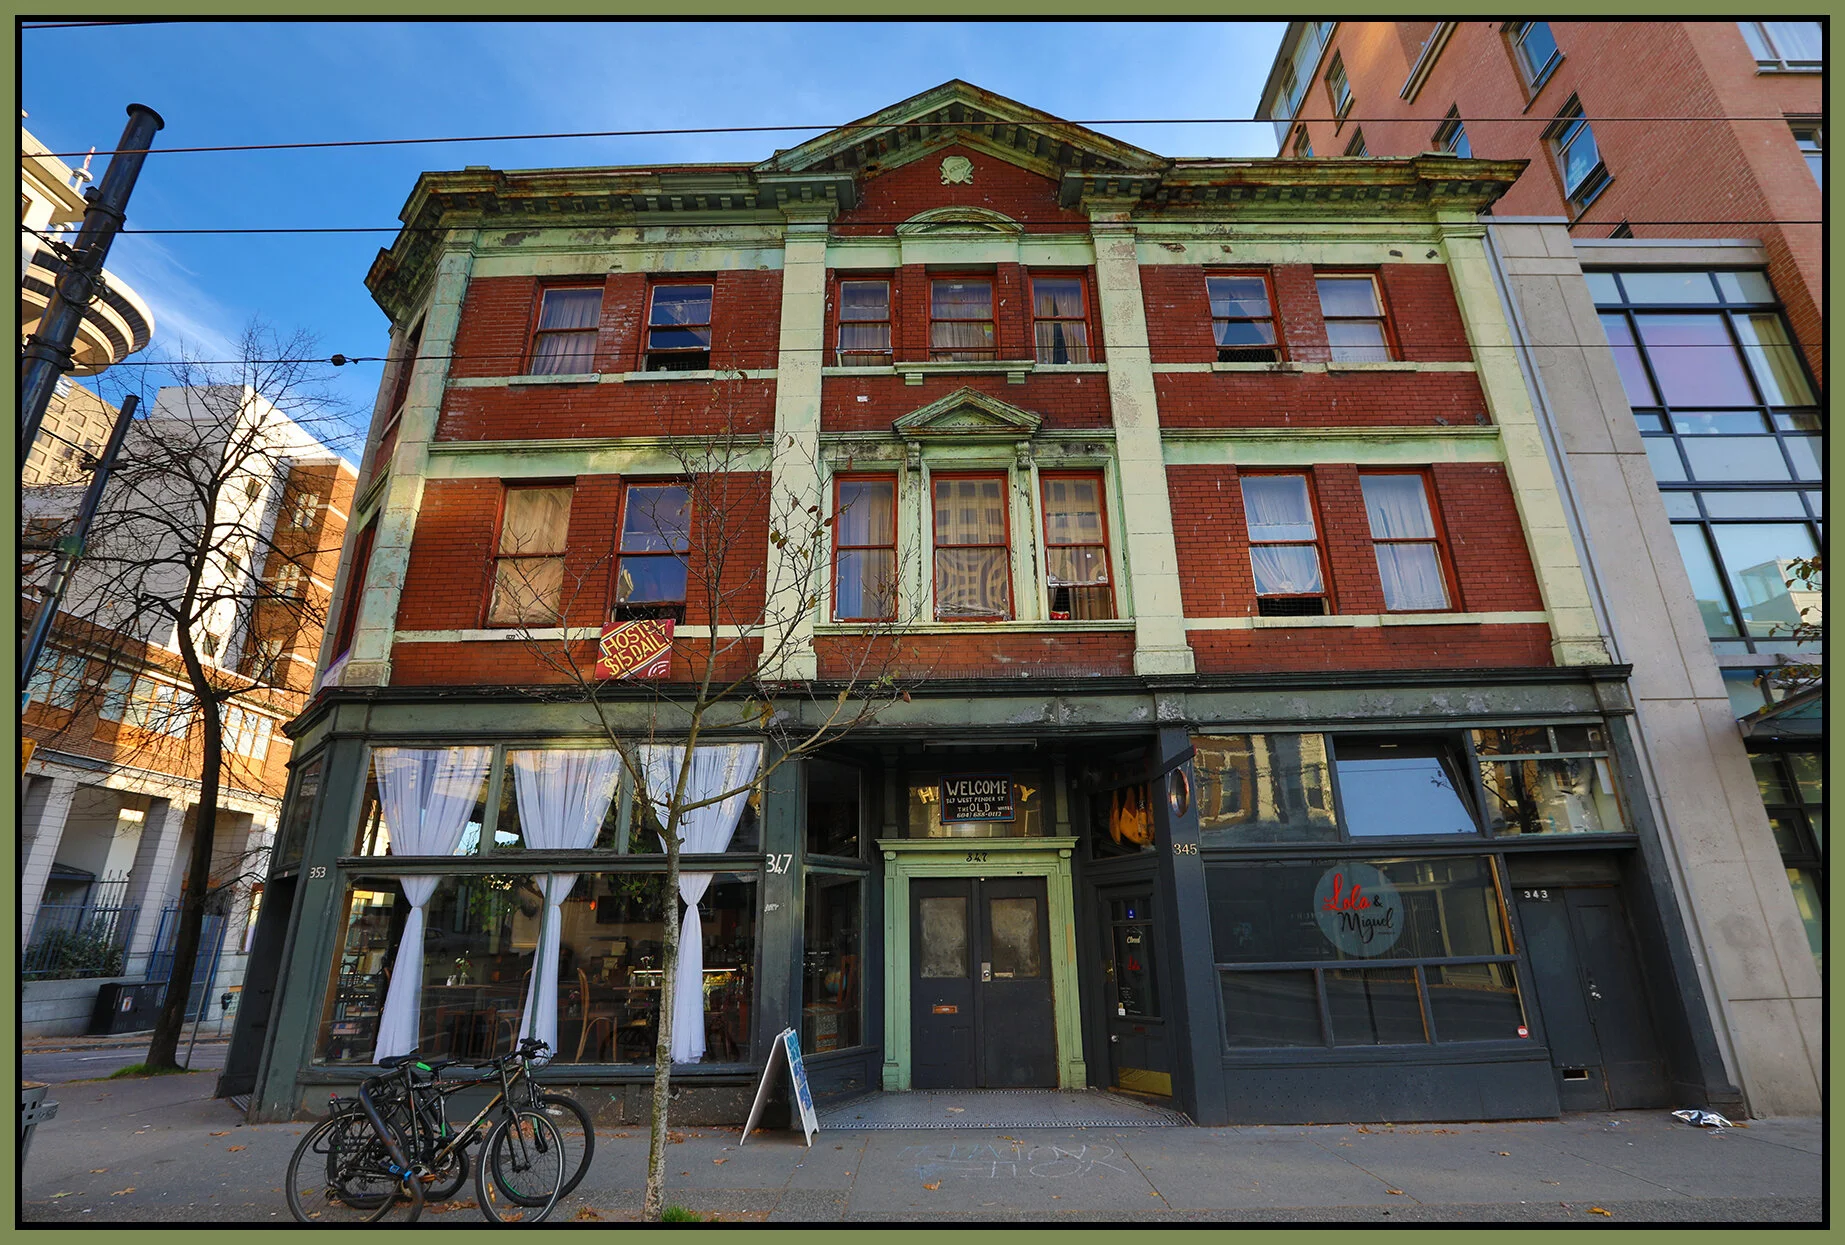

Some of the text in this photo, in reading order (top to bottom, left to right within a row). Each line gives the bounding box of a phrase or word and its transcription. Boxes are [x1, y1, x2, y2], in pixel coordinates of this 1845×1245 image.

[602, 620, 666, 656] HOSTEL
[604, 650, 633, 676] $15
[946, 780, 1008, 796] WELCOME
[969, 803, 991, 812] OLD
[966, 852, 988, 862] 347
[1173, 843, 1198, 855] 345
[766, 853, 793, 875] 347
[309, 866, 326, 879] 353
[1322, 873, 1383, 911] Lola &
[1524, 890, 1549, 899] 343
[1337, 907, 1394, 944] Miguel
